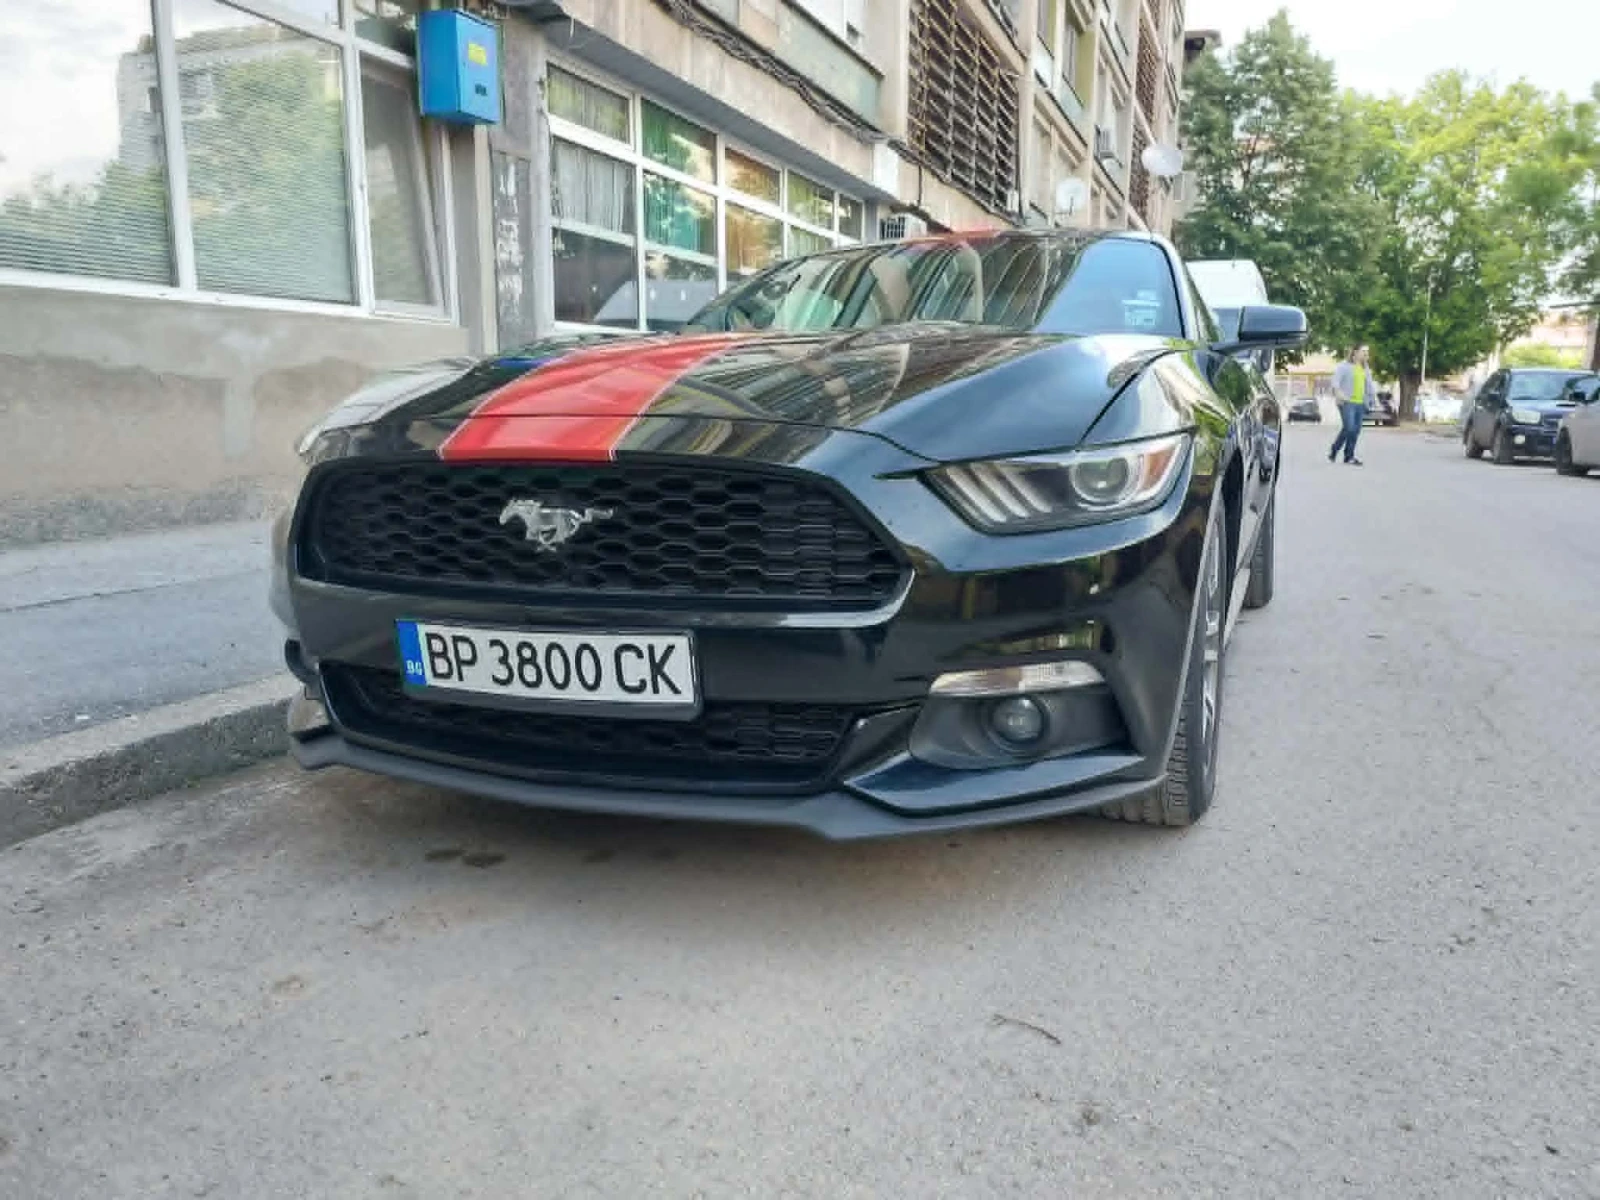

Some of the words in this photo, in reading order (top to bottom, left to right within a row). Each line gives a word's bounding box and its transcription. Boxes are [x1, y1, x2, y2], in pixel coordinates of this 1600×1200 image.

[425, 632, 477, 682] BP
[488, 638, 602, 692] 3800
[614, 643, 682, 695] CK
